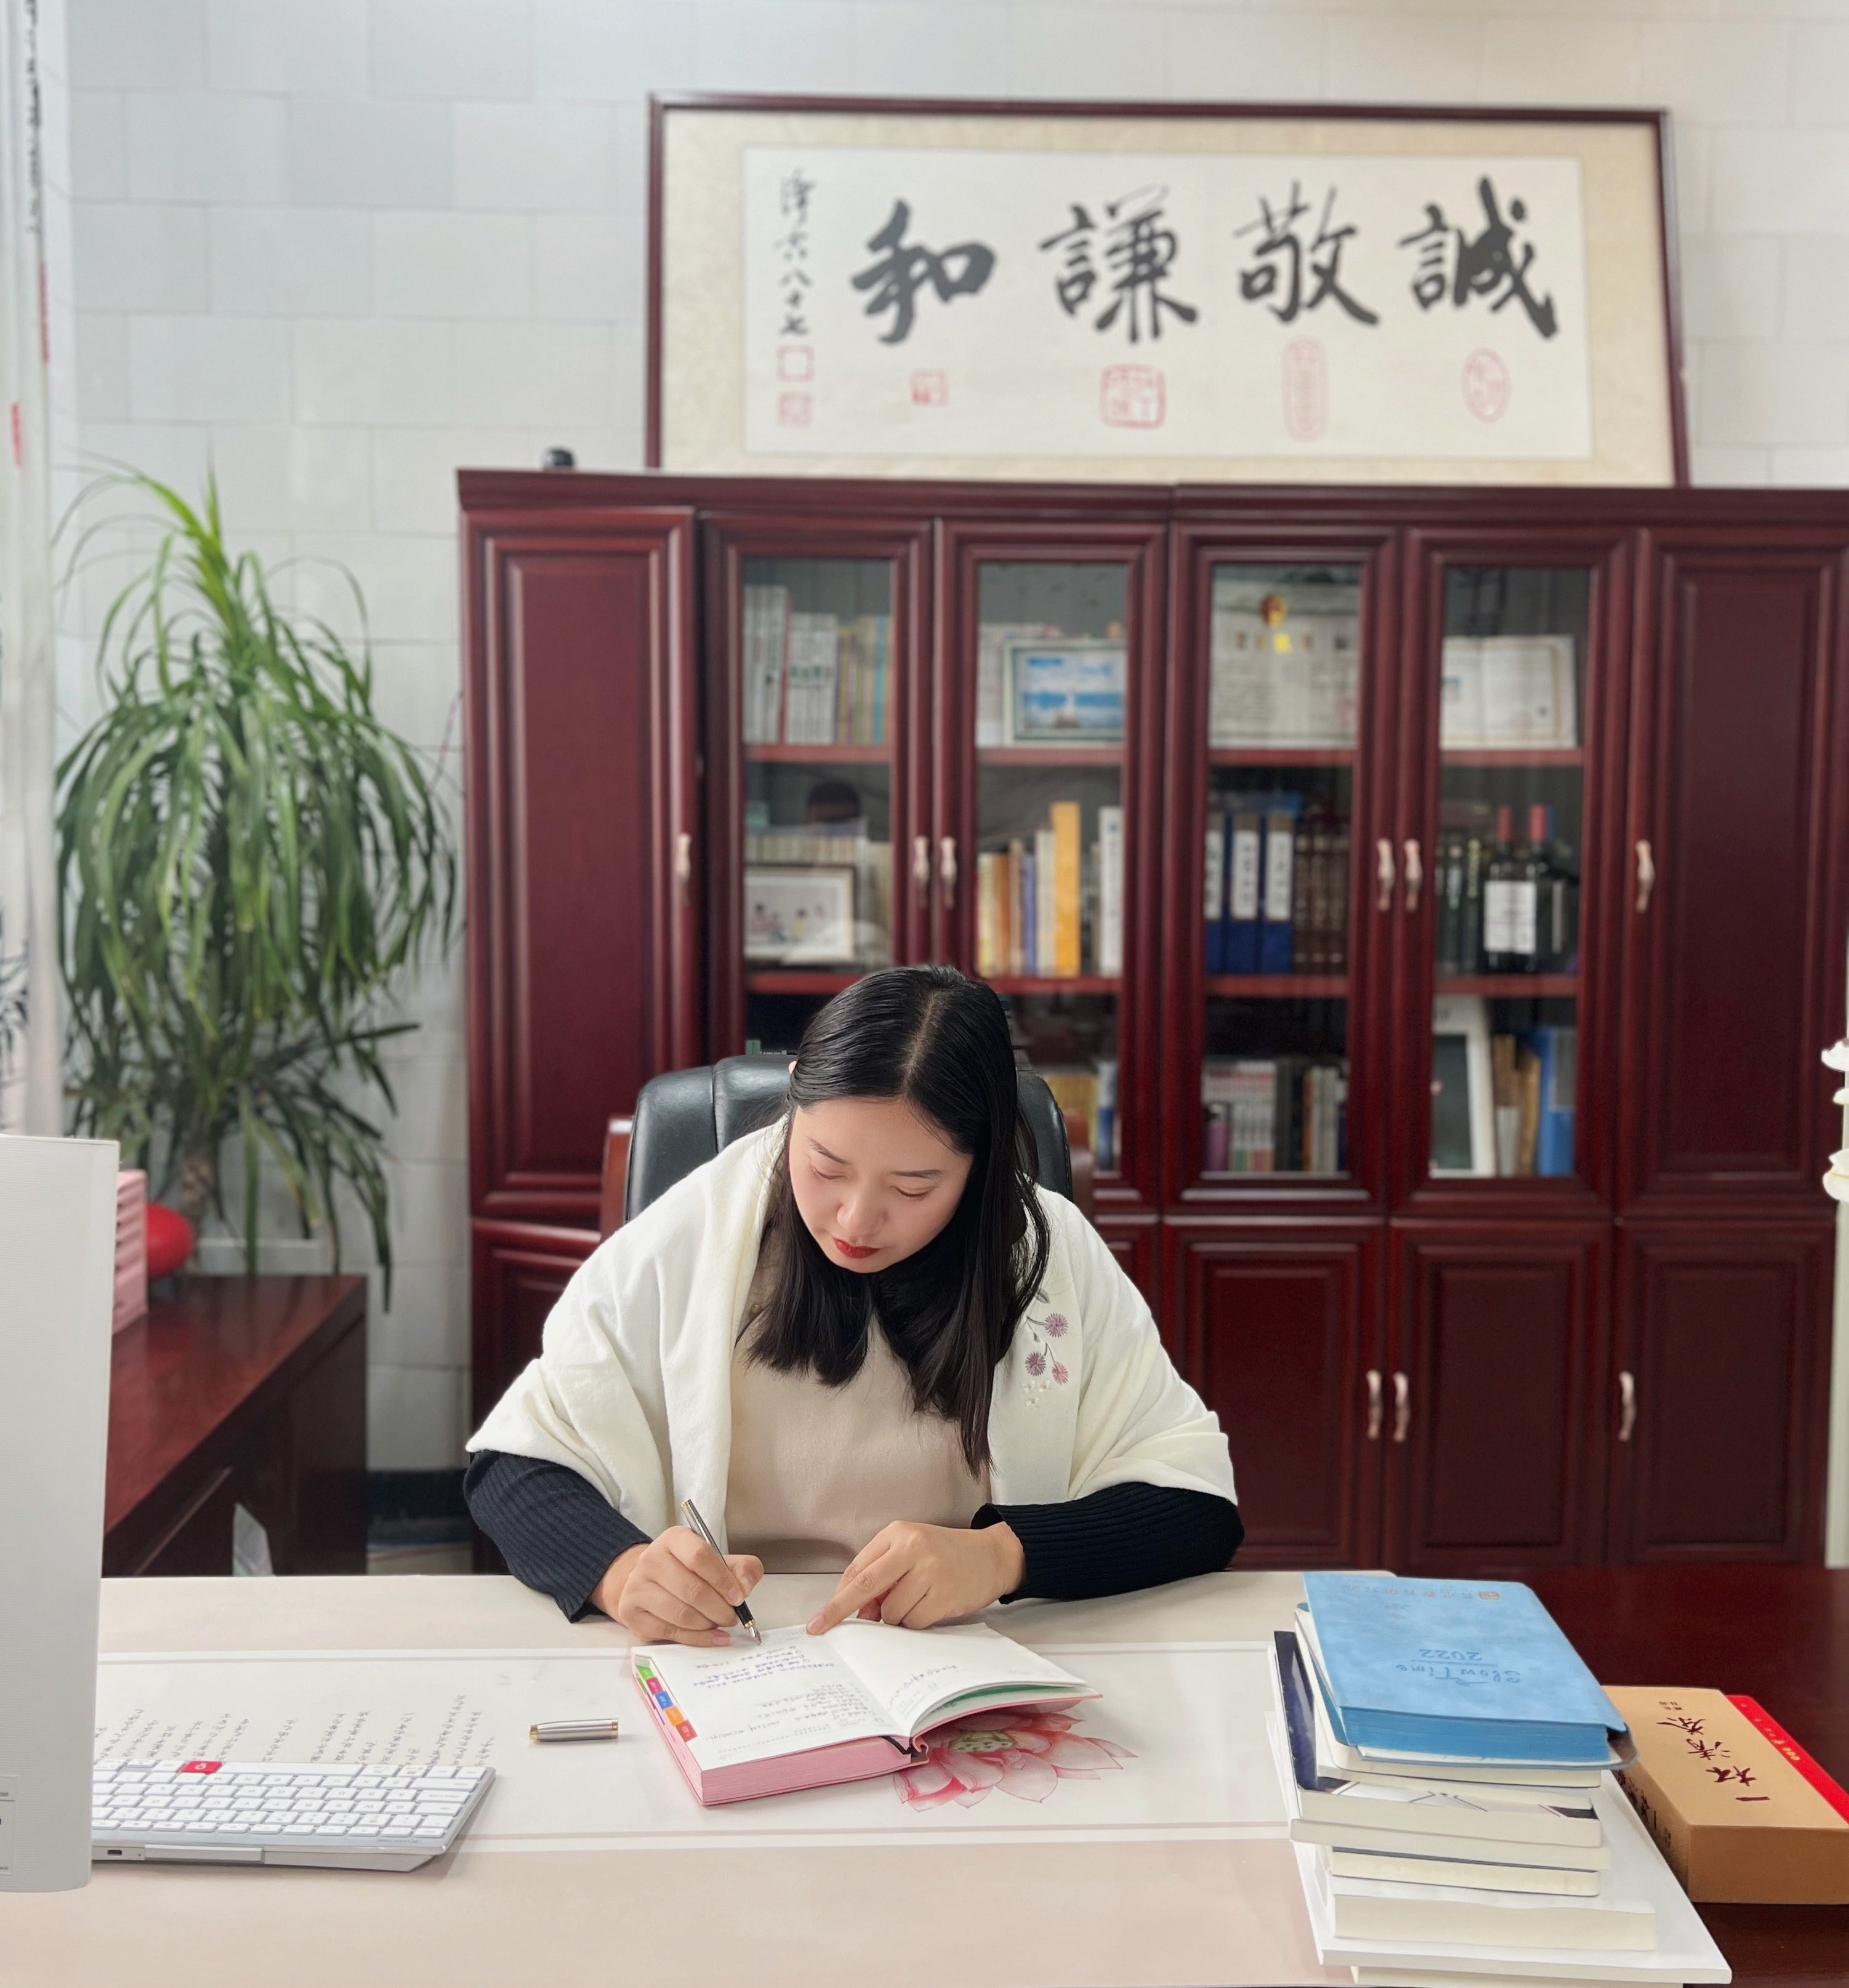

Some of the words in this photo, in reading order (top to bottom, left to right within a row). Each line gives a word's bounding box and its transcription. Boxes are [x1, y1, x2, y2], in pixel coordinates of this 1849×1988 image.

[1419, 1649, 1483, 1662] 2022
[1395, 1664, 1460, 1679] Time
[1460, 1668, 1521, 1684] Slow
[1656, 1716, 1771, 1802] 一杯清茶
